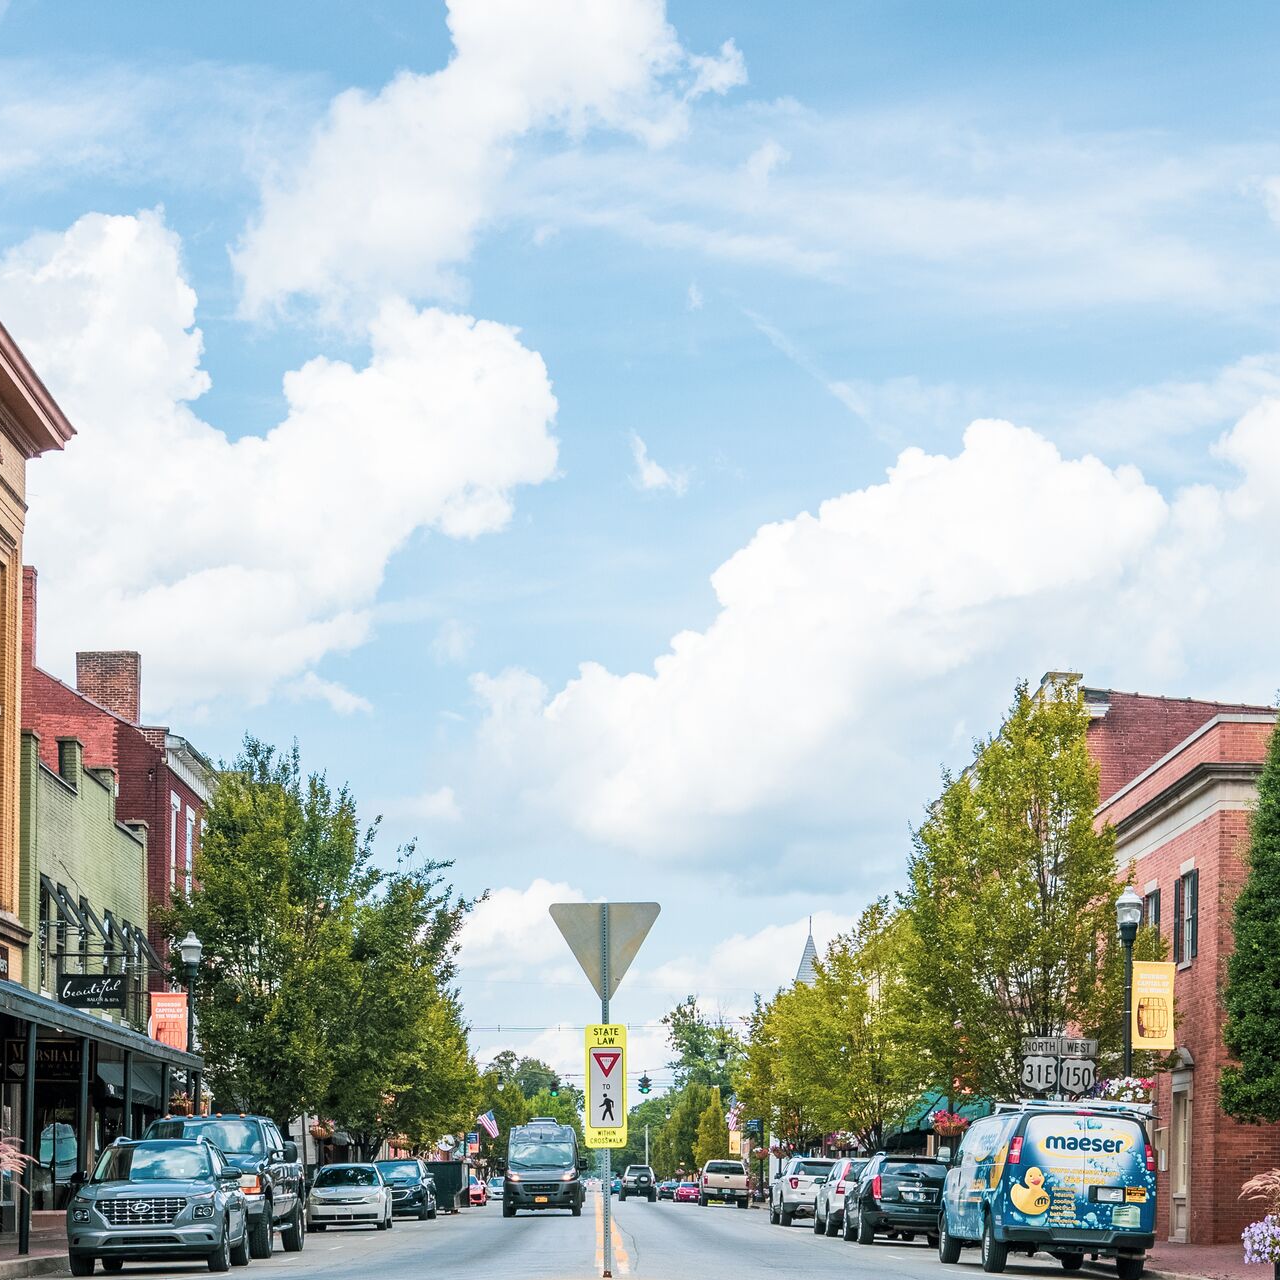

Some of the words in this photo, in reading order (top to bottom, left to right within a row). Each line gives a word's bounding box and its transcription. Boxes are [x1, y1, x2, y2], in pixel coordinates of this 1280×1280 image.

[61, 977, 122, 1005] beautiful
[593, 1028, 619, 1036] STATE
[1025, 1041, 1056, 1052] NORTH
[1067, 1042, 1092, 1053] WEST
[1025, 1064, 1053, 1084] 31E
[1065, 1066, 1091, 1087] 150
[1045, 1135, 1124, 1153] maeser
